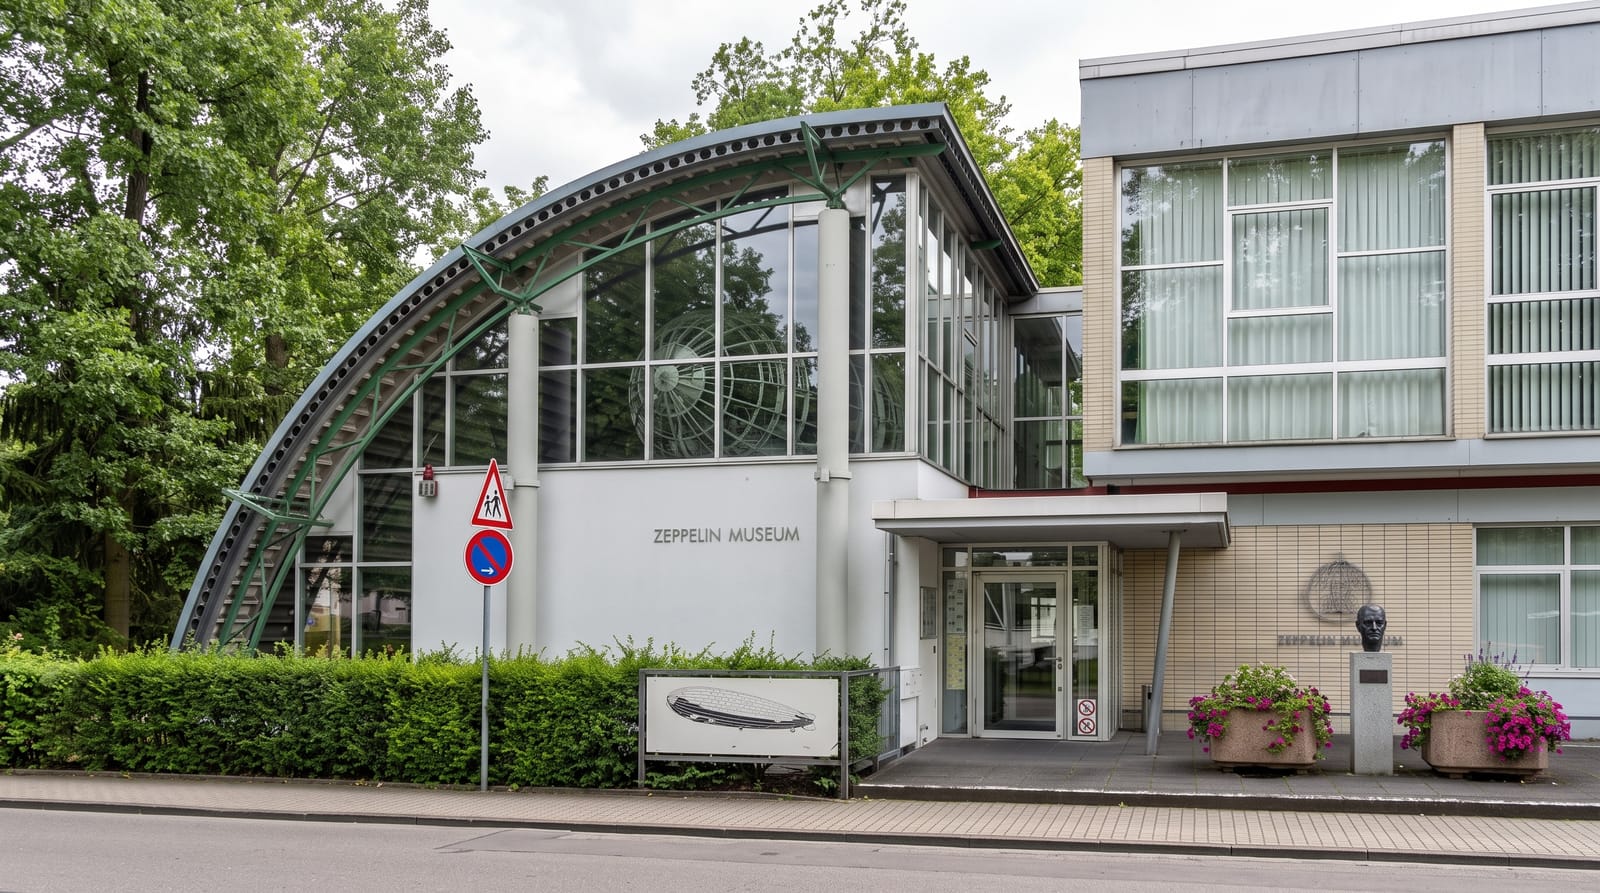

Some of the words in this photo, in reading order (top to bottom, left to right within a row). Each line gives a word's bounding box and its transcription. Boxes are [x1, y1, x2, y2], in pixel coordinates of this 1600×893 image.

[653, 527, 721, 544] ZEPPELIN
[728, 526, 800, 543] MUSEUM
[1341, 634, 1403, 646] MUUM
